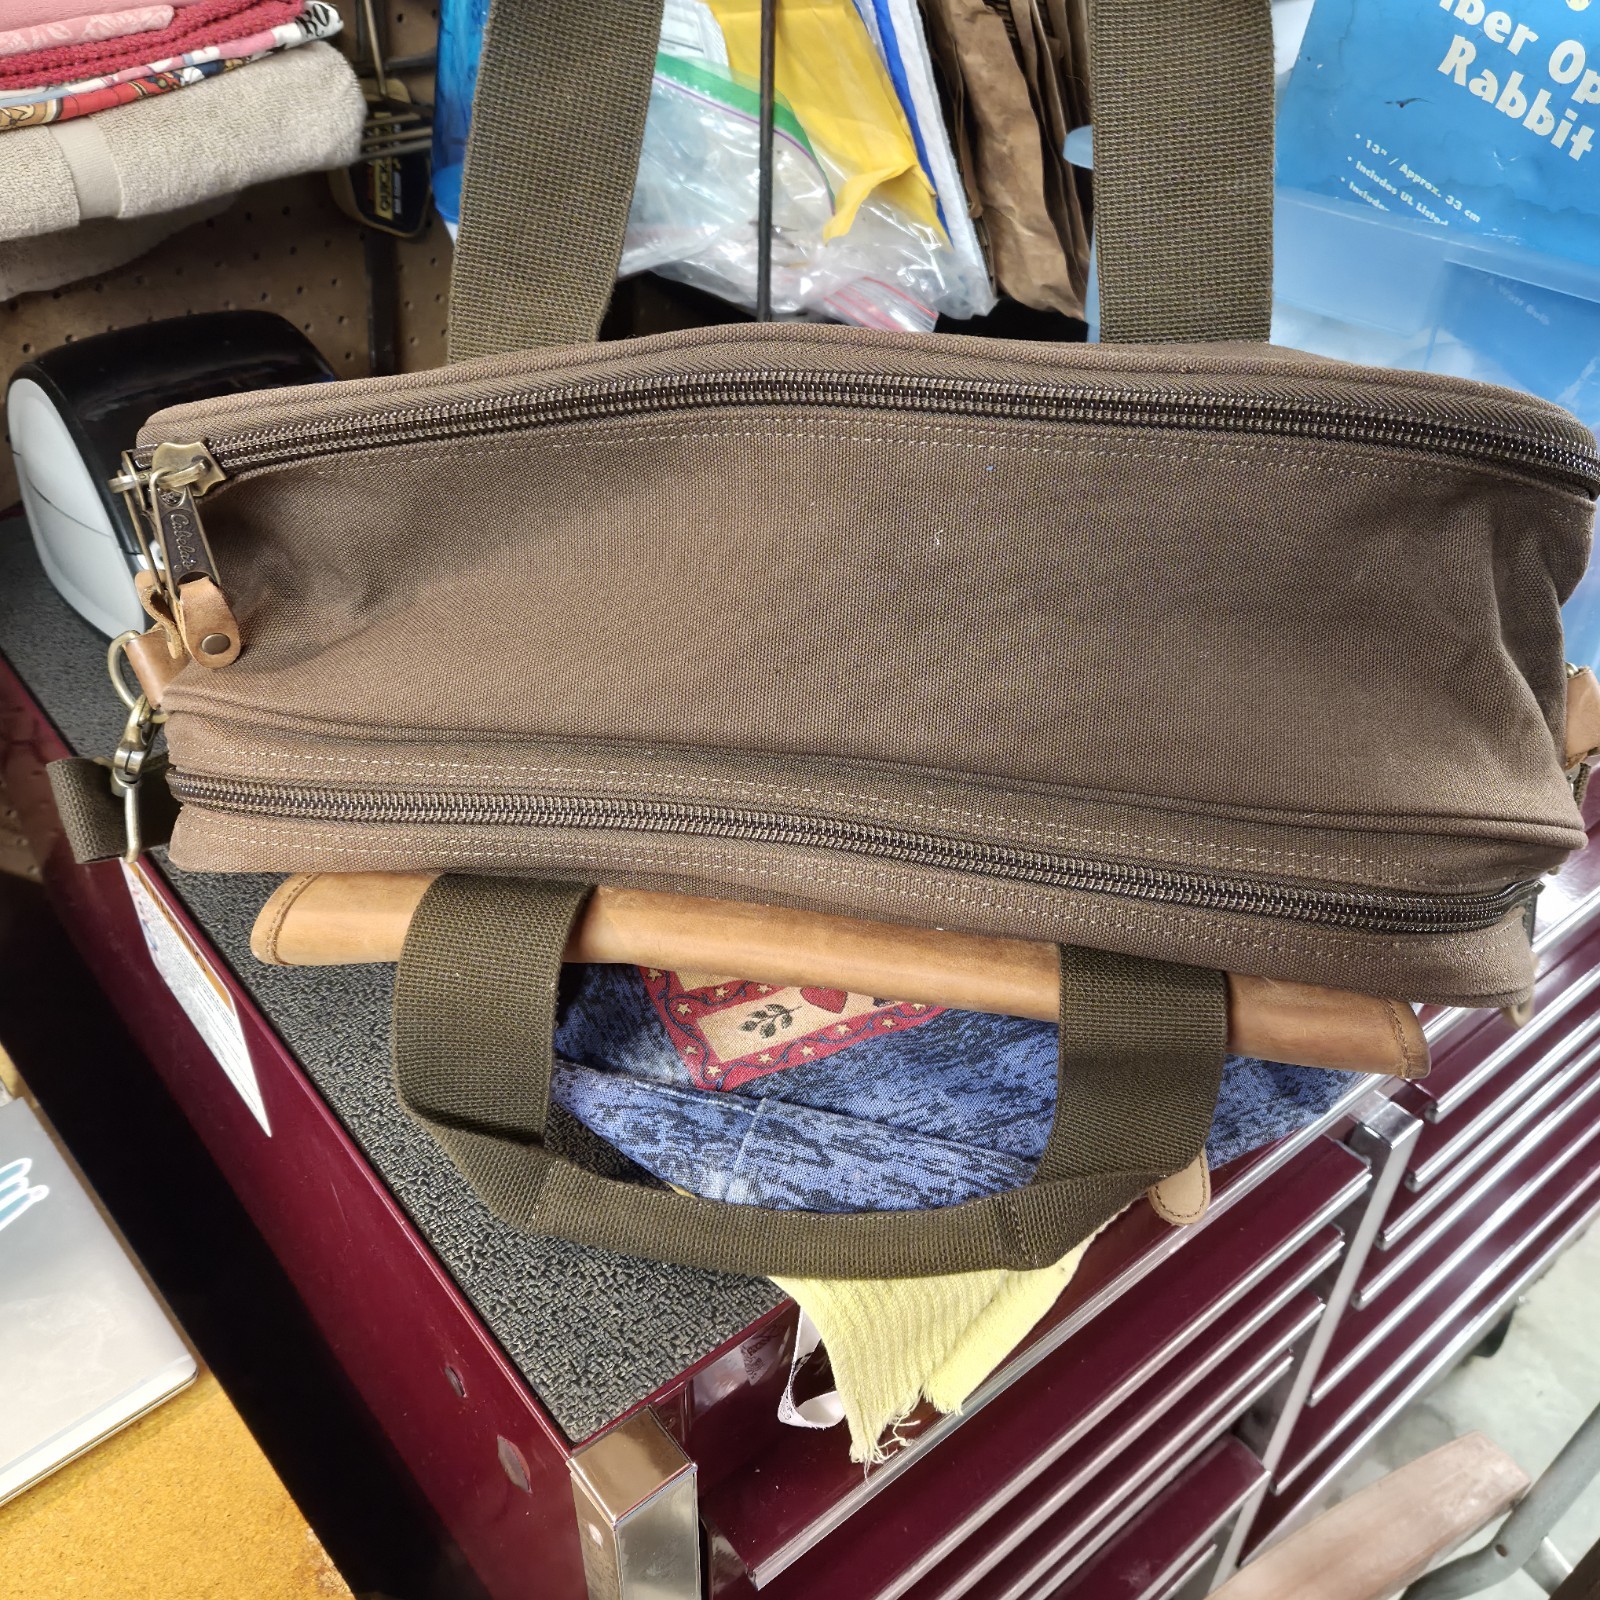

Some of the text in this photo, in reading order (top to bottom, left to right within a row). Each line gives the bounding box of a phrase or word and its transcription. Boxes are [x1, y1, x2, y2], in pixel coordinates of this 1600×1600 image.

[1437, 34, 1595, 161] Rabbit
[1355, 160, 1398, 195] Includes
[1365, 139, 1388, 156] 13"
[1399, 163, 1442, 198] Approx.
[1445, 194, 1463, 211] 33
[1464, 208, 1481, 223] cm
[170, 513, 198, 571] Cabela's
